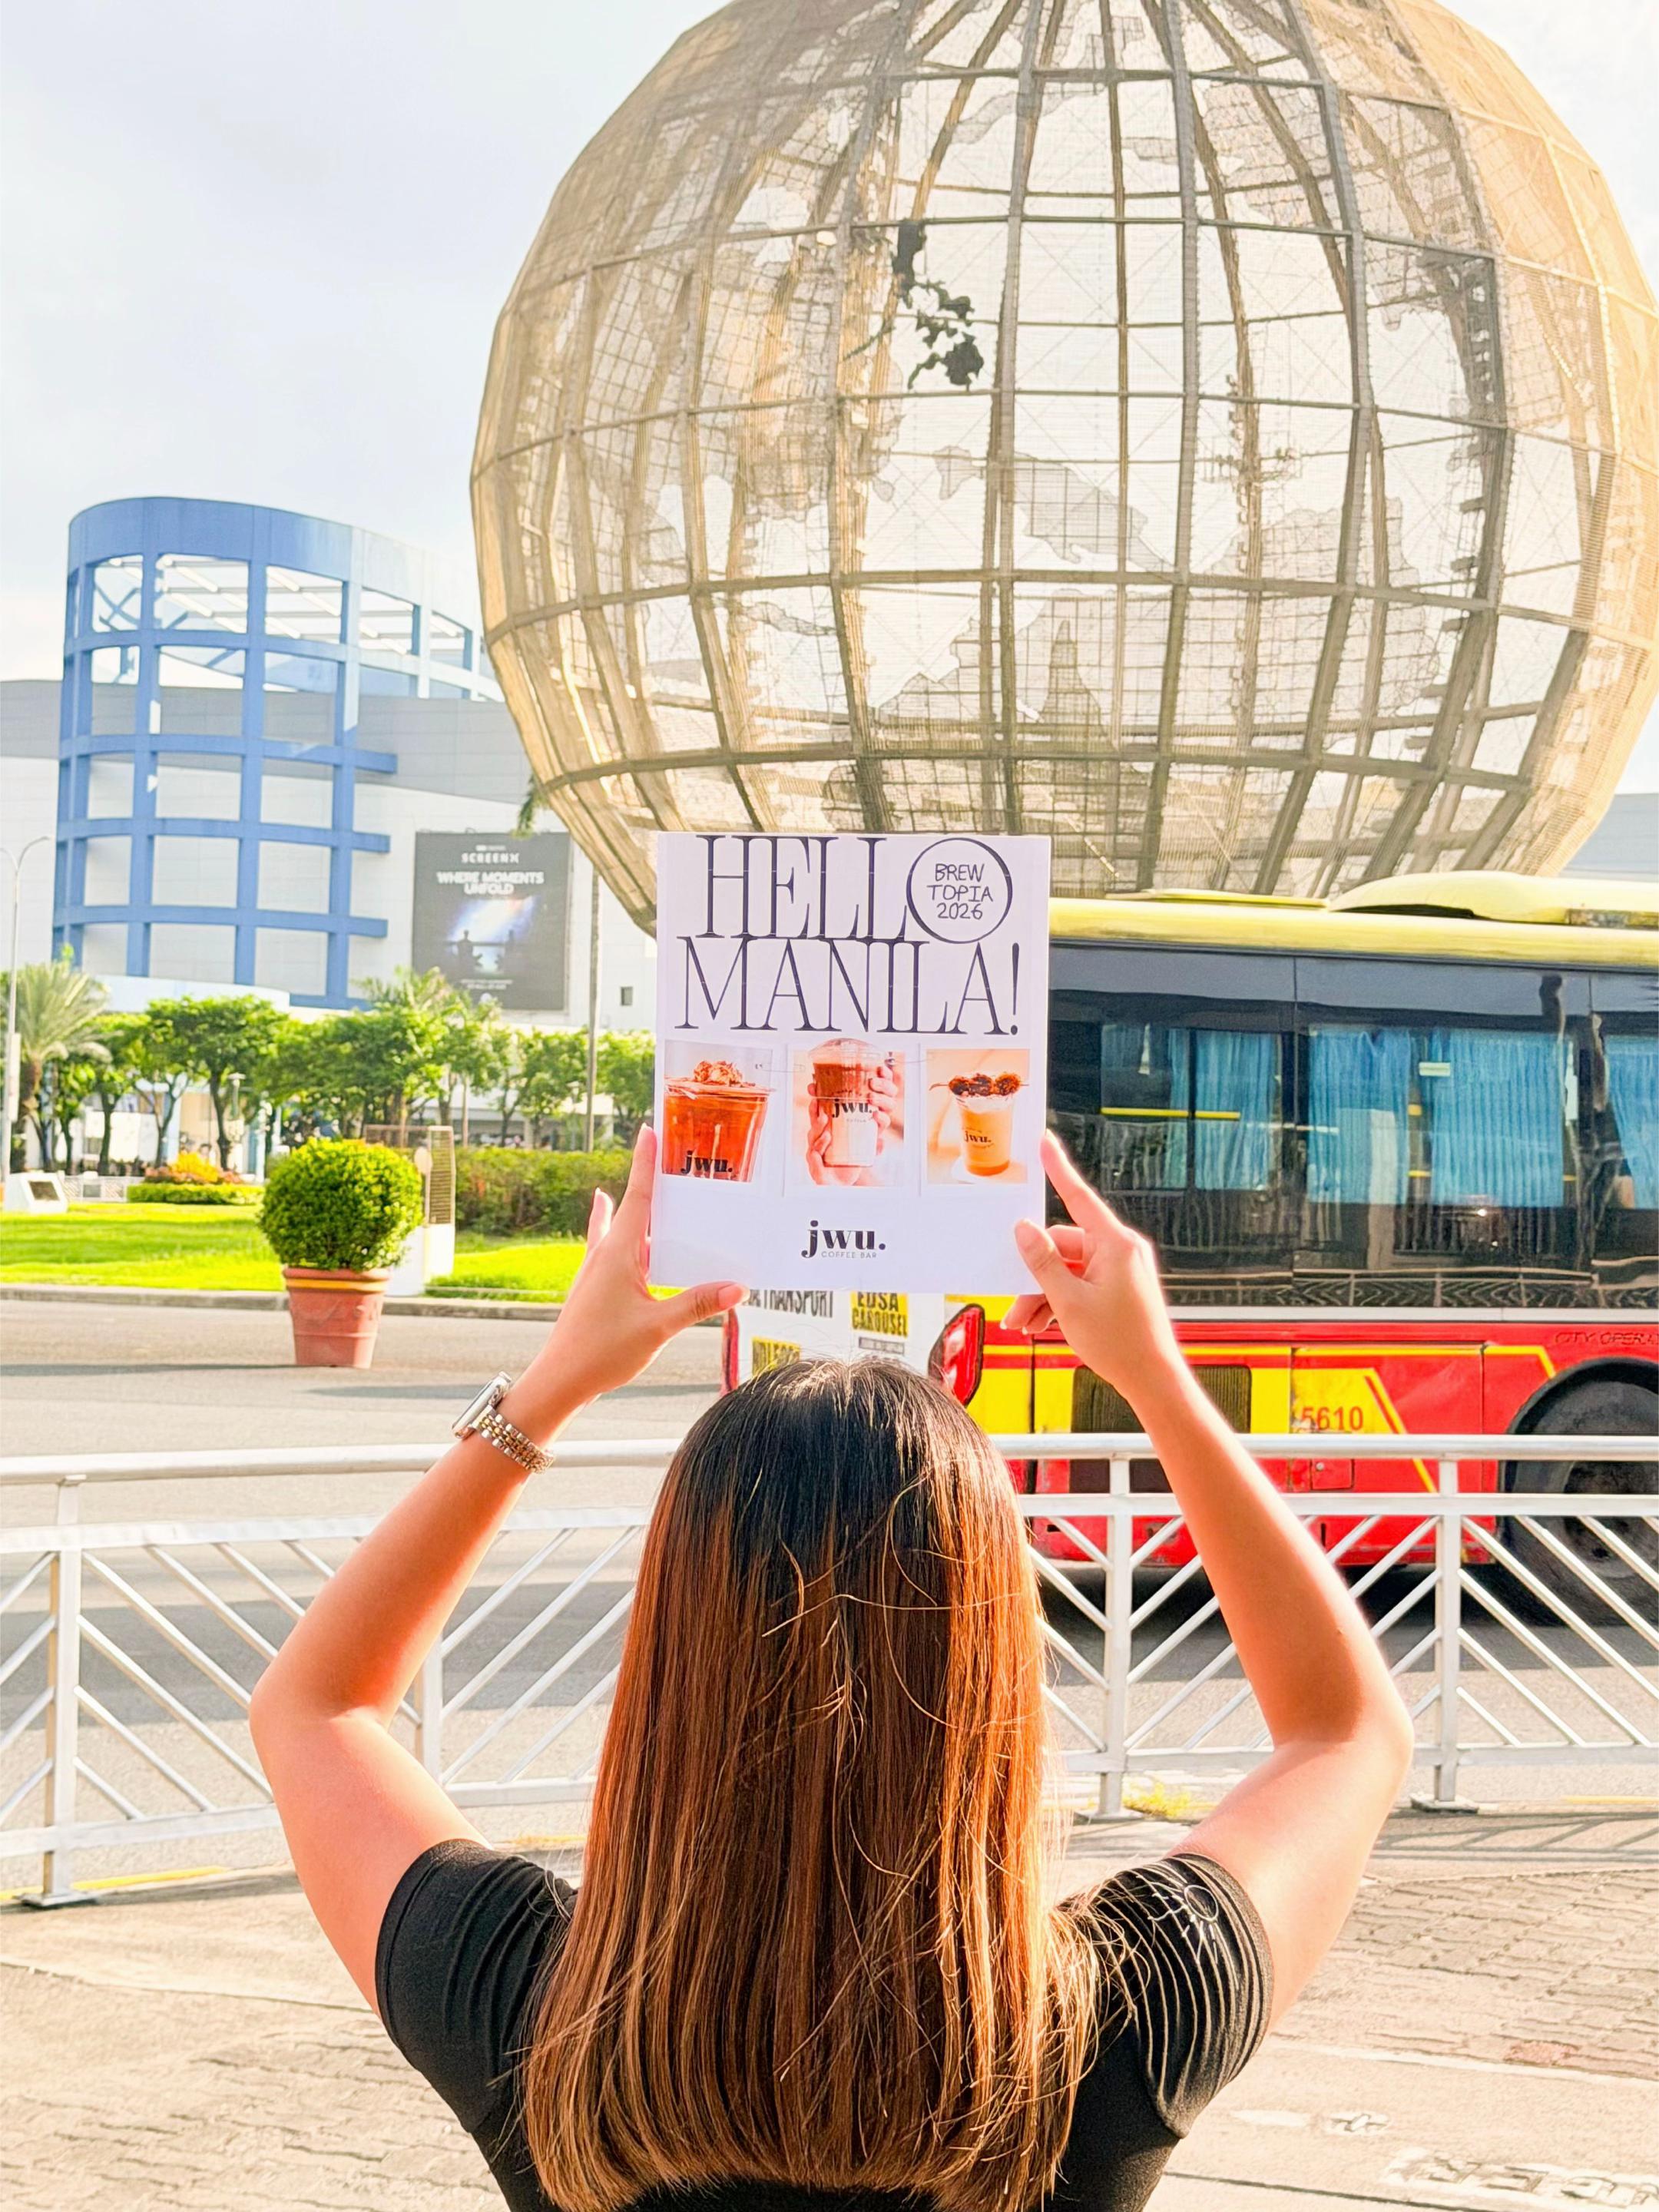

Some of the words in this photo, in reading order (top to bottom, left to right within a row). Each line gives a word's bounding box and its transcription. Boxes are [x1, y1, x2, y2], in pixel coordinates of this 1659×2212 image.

[436, 871, 479, 884] WHERE
[482, 871, 545, 884] MOMENTS
[935, 863, 985, 882] BREW
[464, 883, 515, 895] UNFOLD
[696, 835, 1013, 944] HELLO
[926, 885, 994, 902] TOPIA
[936, 902, 983, 920] 2026
[674, 936, 1020, 1036] MANILA!
[832, 1098, 873, 1118] jwu.
[680, 1151, 733, 1174] jwu.
[801, 1220, 886, 1259] jwu.
[857, 1292, 899, 1312] EDSA
[852, 1306, 908, 1337] CAROUSEL
[1301, 1406, 1363, 1432] 5610
